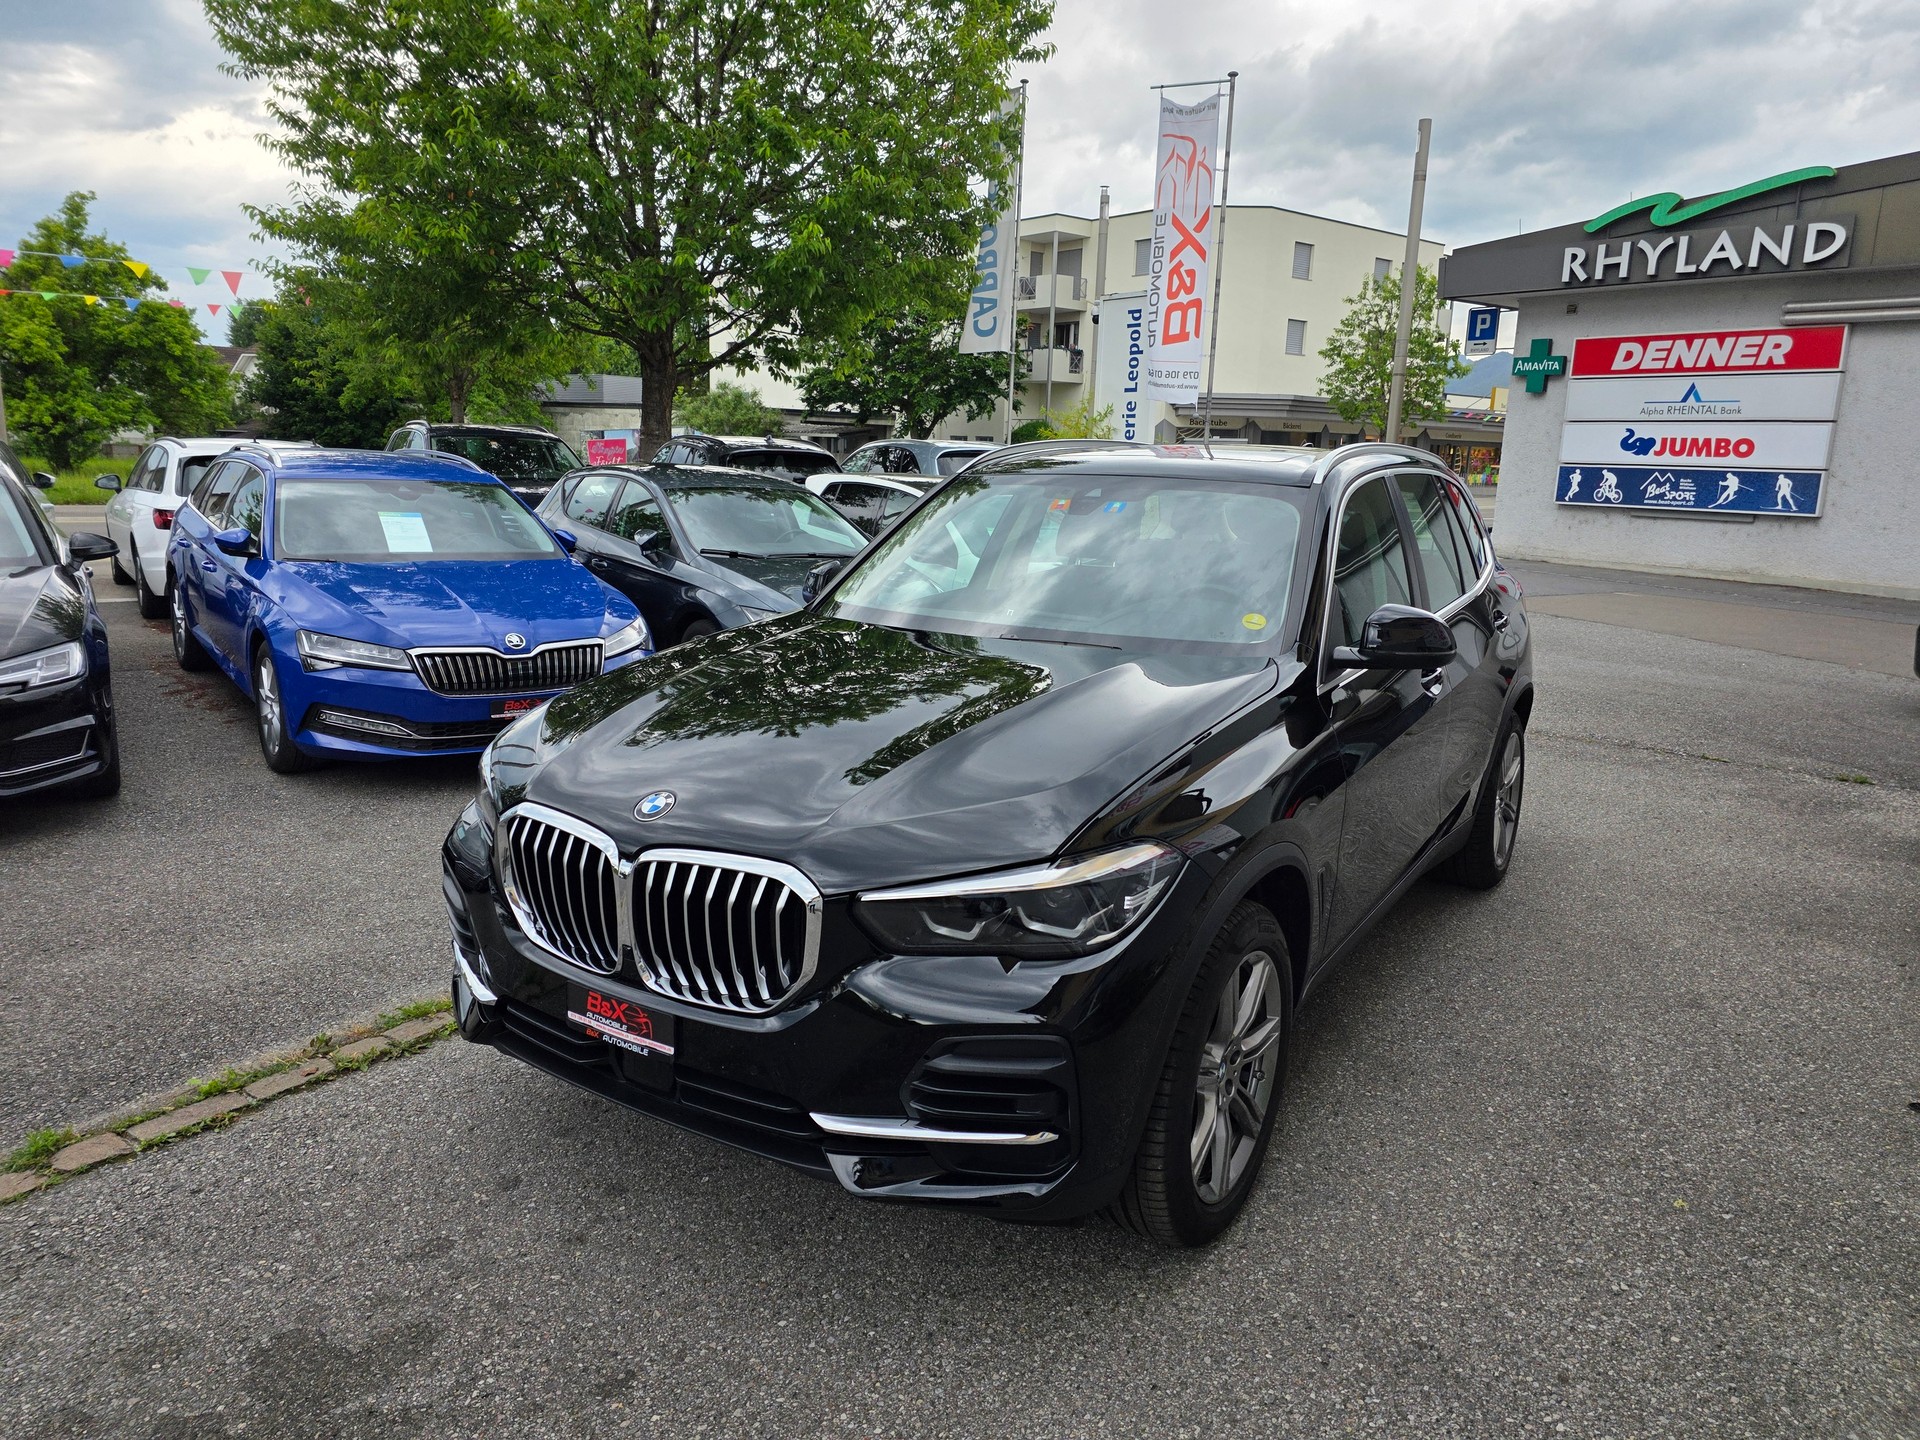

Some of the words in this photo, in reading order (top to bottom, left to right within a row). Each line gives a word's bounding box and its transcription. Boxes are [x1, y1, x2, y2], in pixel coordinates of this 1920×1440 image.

[1561, 222, 1847, 283] RHYLAND
[1475, 313, 1491, 337] P
[1123, 308, 1144, 393] Leopold
[1610, 335, 1793, 371] DENNER
[1514, 359, 1560, 373] AMAVITA
[1640, 407, 1664, 417] Alpha
[1666, 405, 1718, 416] RHEINTAL
[1720, 406, 1742, 415] Bank
[1189, 418, 1228, 427] Backtube
[1653, 437, 1755, 459] JUMBO
[1645, 482, 1671, 499] Beat
[1664, 491, 1696, 501] SPORT
[504, 699, 530, 710] B&X
[586, 990, 629, 1023] B&X
[586, 1011, 628, 1032] AUTOMOBILE
[602, 1034, 649, 1056] AUTOMOBILE
